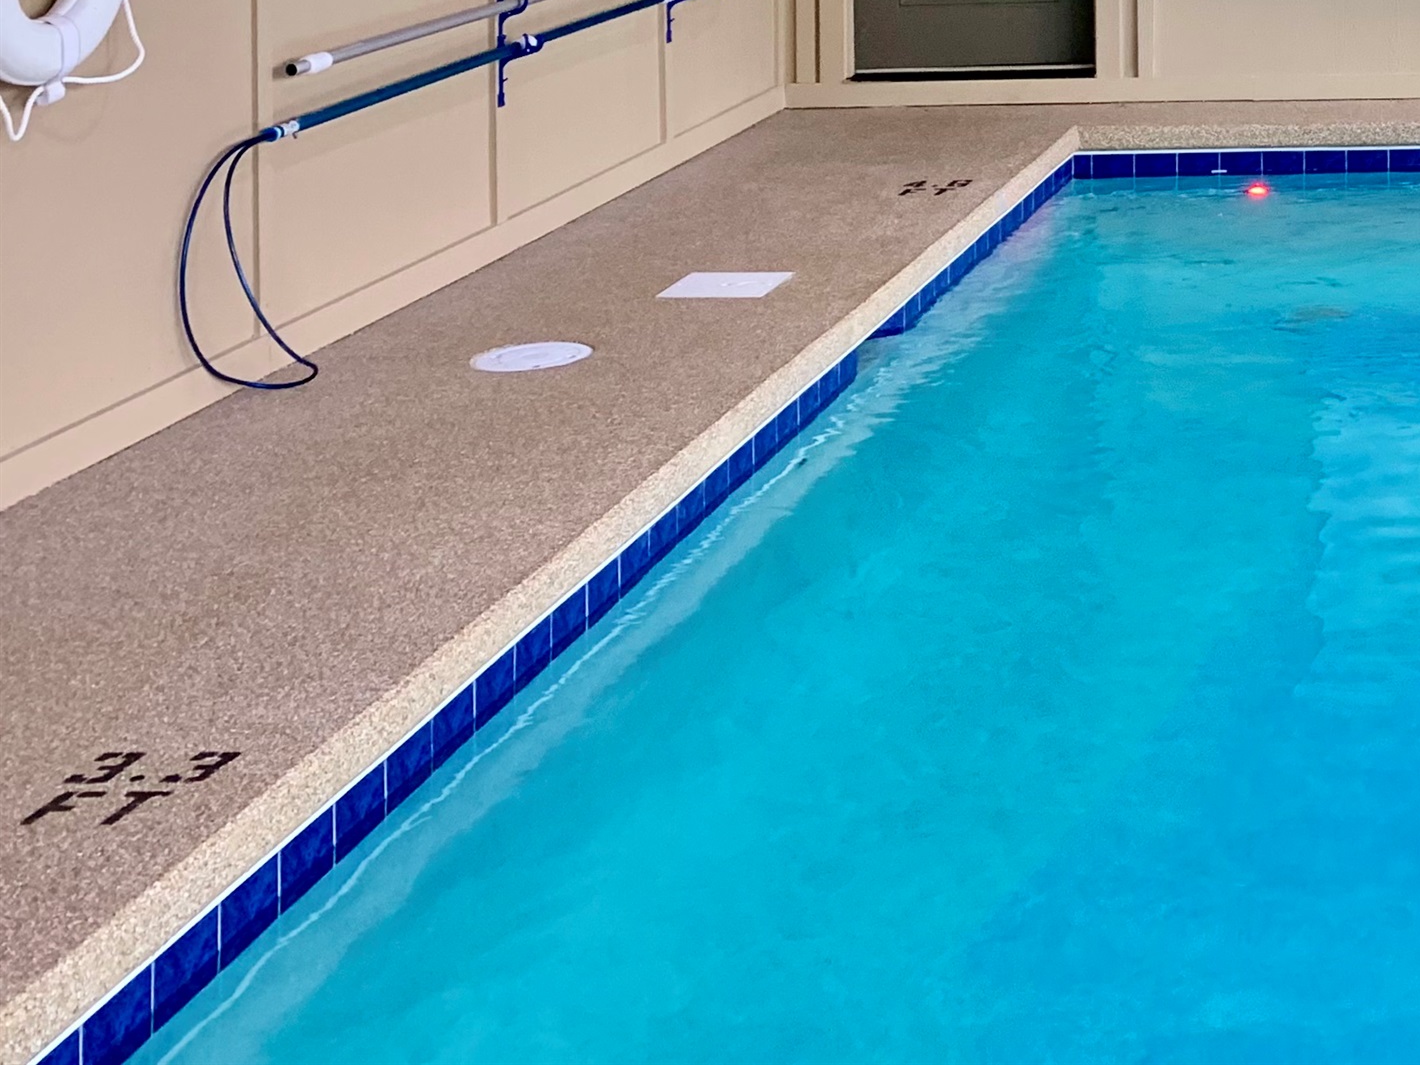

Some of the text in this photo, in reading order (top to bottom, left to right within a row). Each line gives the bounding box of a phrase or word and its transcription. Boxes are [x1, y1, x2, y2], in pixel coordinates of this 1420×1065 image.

[898, 188, 956, 196] FT
[63, 751, 242, 784] 3.3
[20, 790, 174, 825] FT
